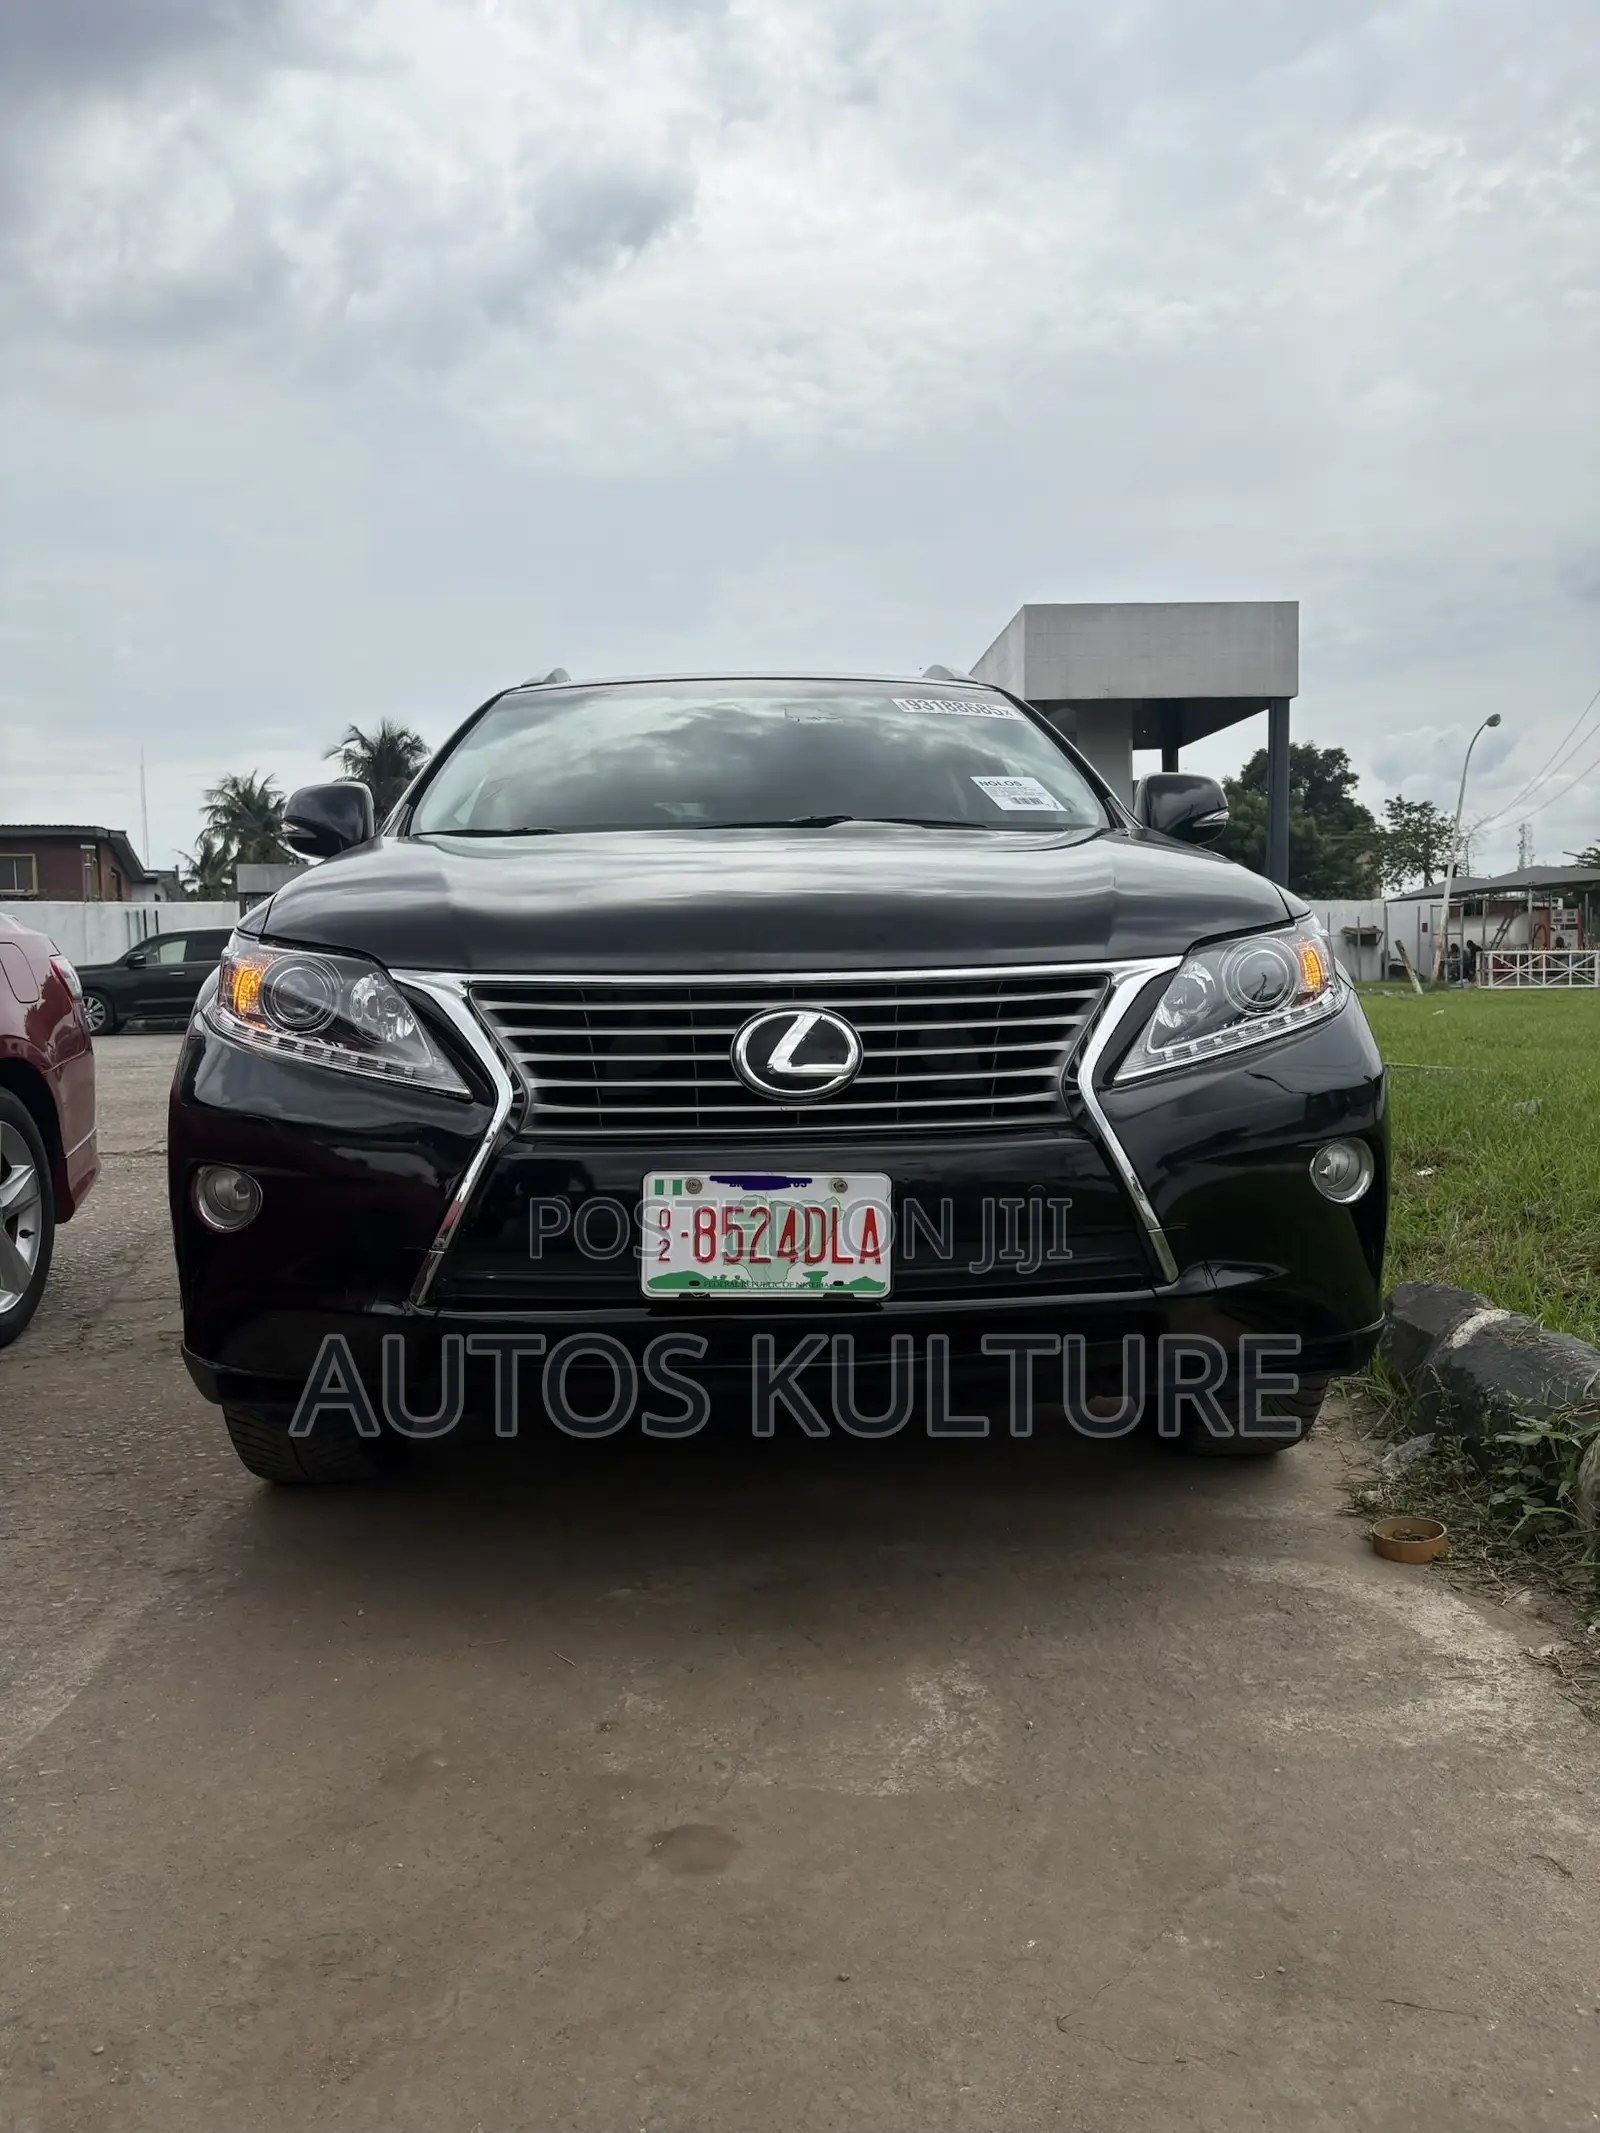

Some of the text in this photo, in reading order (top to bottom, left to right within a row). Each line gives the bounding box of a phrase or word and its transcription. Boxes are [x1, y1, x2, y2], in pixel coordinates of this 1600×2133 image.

[704, 1280, 740, 1289] FEDERAL
[782, 1280, 794, 1289] OF
[795, 1280, 829, 1289] NIGERIA
